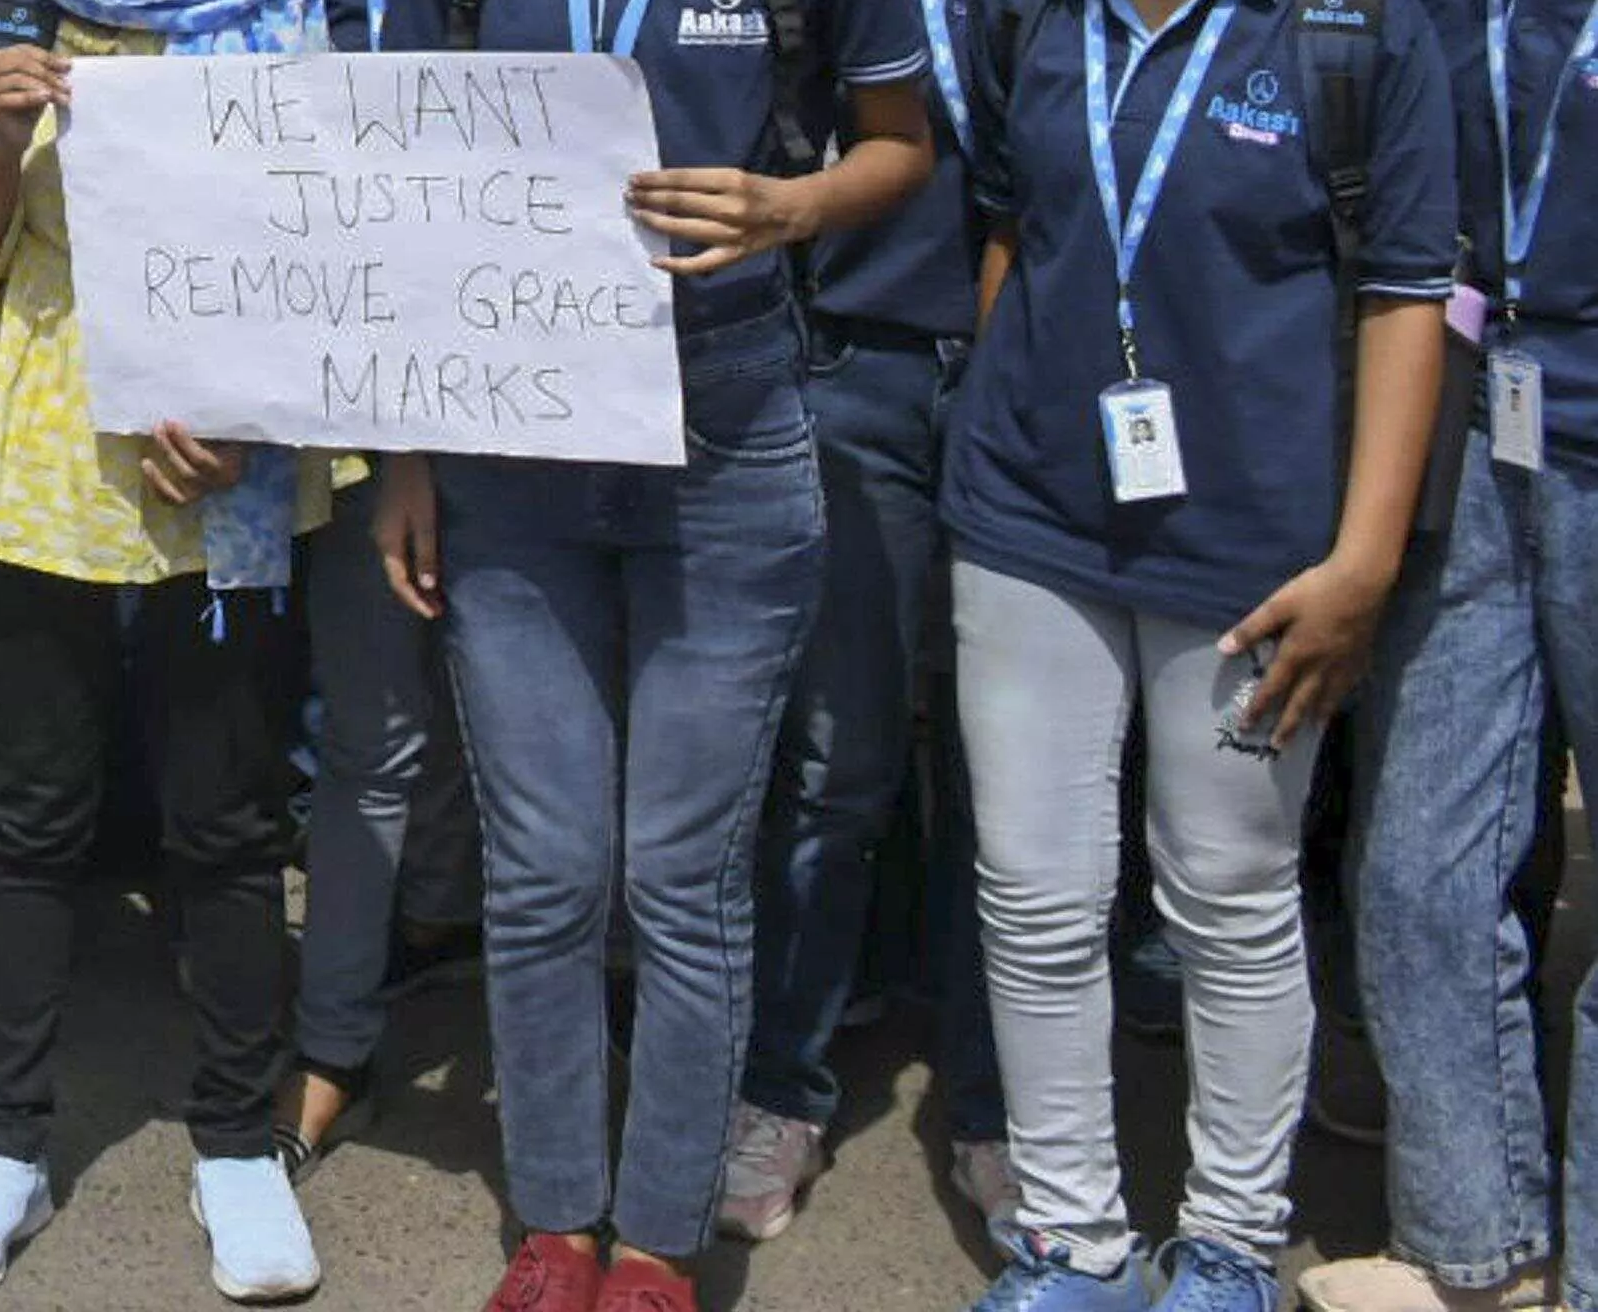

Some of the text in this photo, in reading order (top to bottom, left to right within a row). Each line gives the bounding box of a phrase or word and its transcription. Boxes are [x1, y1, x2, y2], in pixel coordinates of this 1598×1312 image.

[203, 60, 559, 152] WE WANT
[265, 168, 574, 239] JUSTICE
[143, 246, 653, 335] REMOVE GRACE
[321, 351, 575, 429] MARKS
